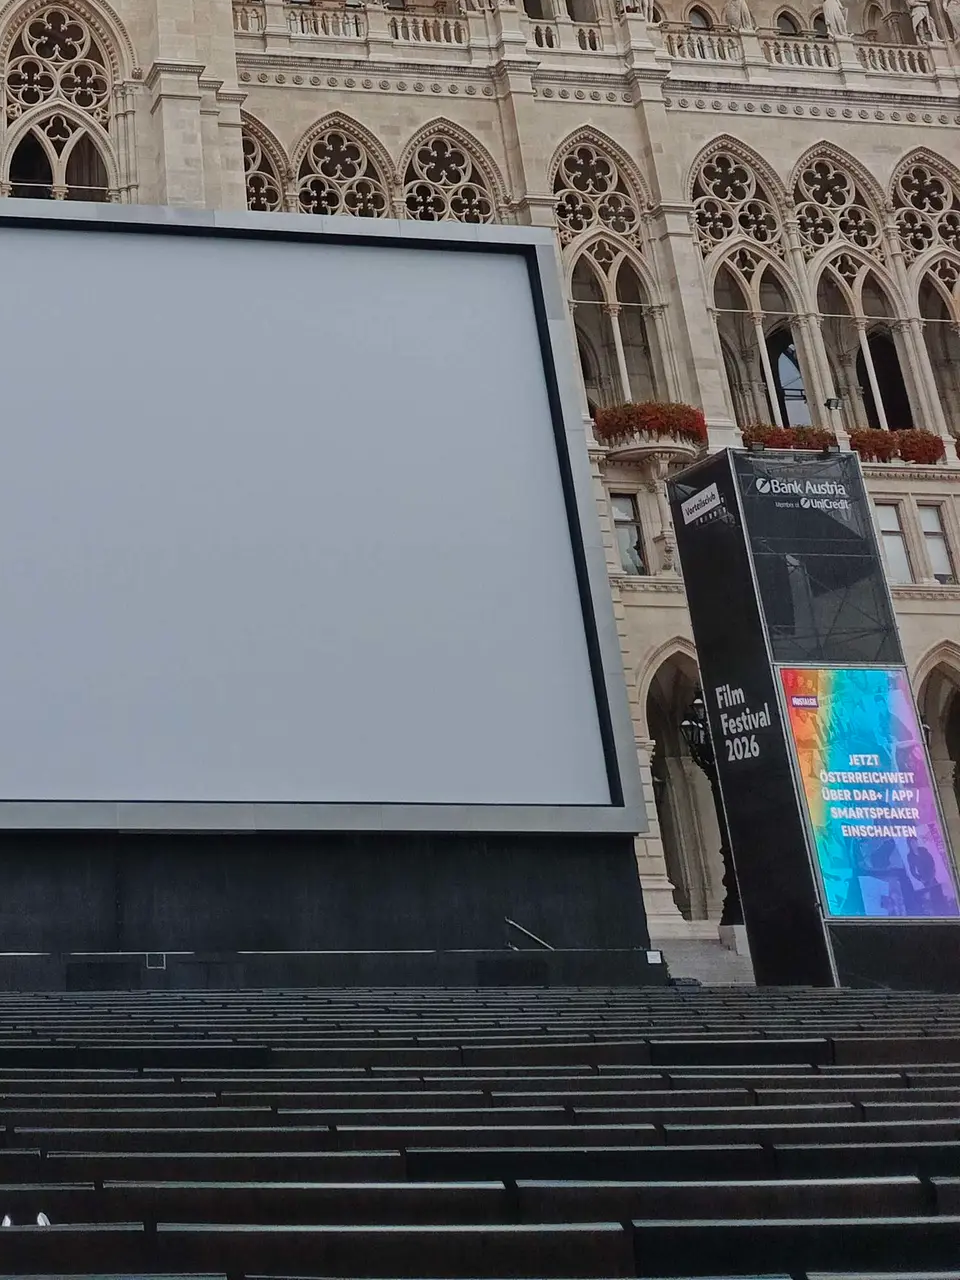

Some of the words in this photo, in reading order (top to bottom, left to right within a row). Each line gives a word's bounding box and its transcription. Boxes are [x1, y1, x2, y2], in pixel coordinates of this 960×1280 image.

[771, 479, 802, 494] Bank
[805, 480, 846, 496] Austria
[811, 498, 849, 510] UniCredit
[715, 683, 745, 709] Film
[721, 702, 771, 736] Festival
[725, 735, 760, 762] 2026
[849, 754, 878, 766] JETZT
[820, 769, 914, 783] ÖSTERREICHWEIT
[822, 787, 851, 801] ÜBER
[853, 789, 882, 801] DAB+
[891, 789, 914, 802] APP
[830, 807, 920, 819] SMARTSPEAKER
[841, 825, 917, 837] EINSCHALTEN
